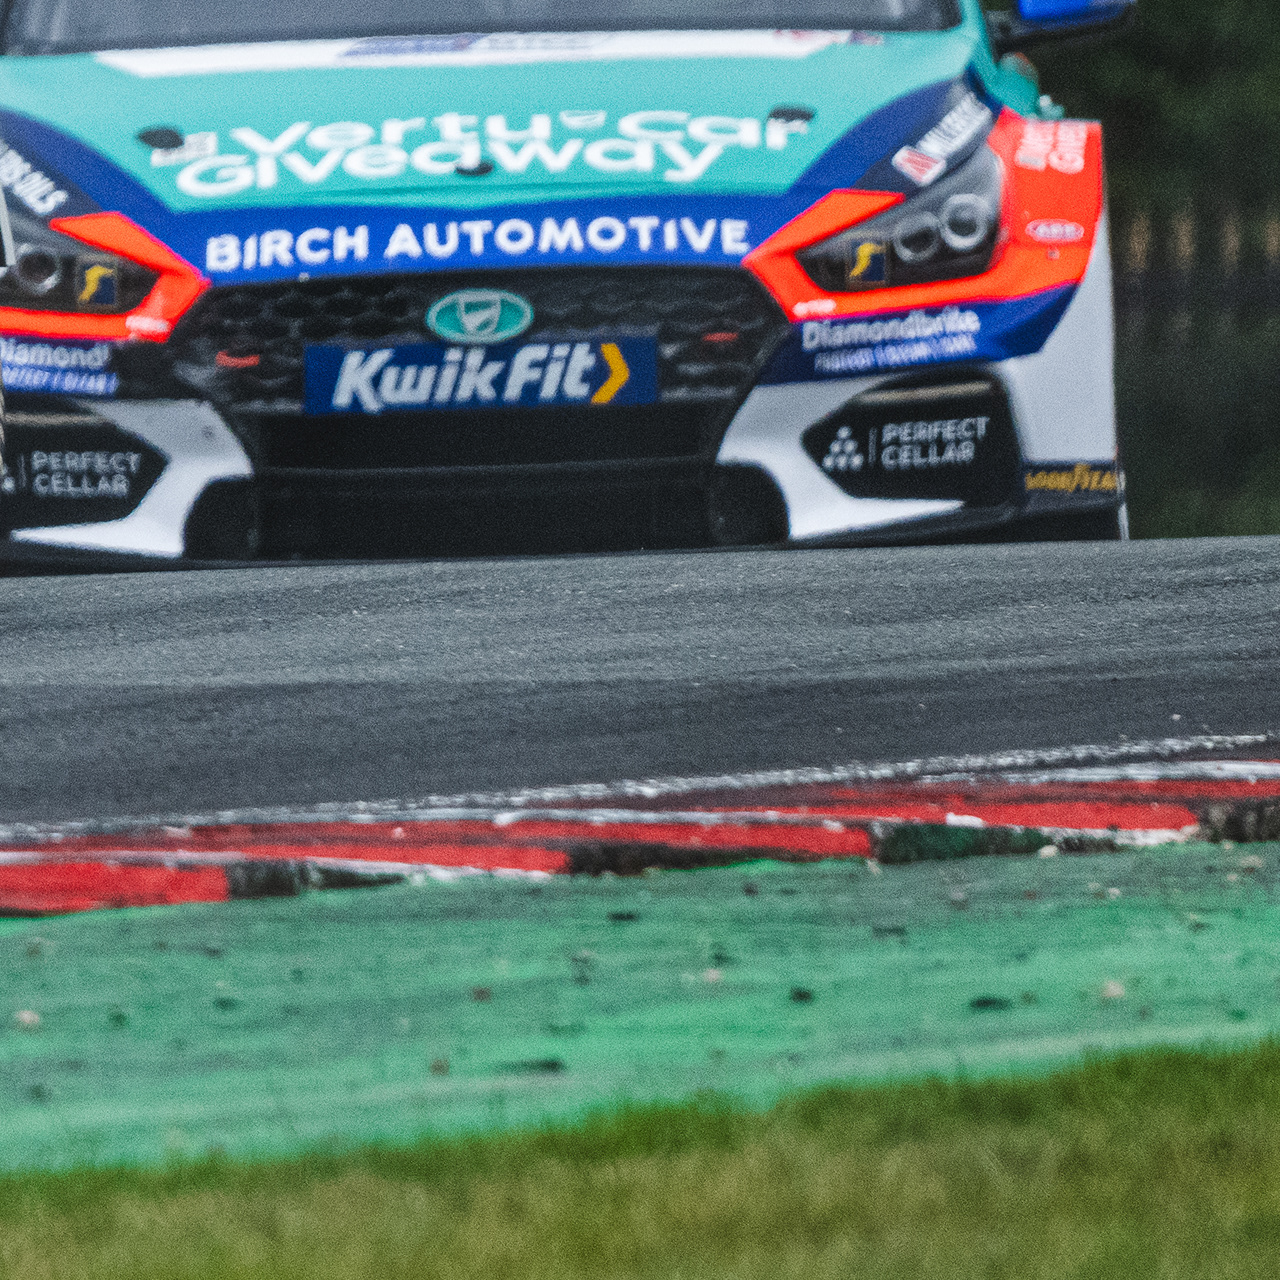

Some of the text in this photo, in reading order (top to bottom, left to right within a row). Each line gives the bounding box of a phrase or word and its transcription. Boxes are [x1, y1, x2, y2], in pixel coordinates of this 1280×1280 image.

[205, 216, 751, 273] BIRCH AUTOMOTIVE
[331, 341, 596, 414] KwikFit
[881, 416, 990, 445] PERFECT
[31, 450, 141, 473] PERFECT
[881, 440, 975, 469] CELLAR
[32, 473, 129, 498] CELLAR
